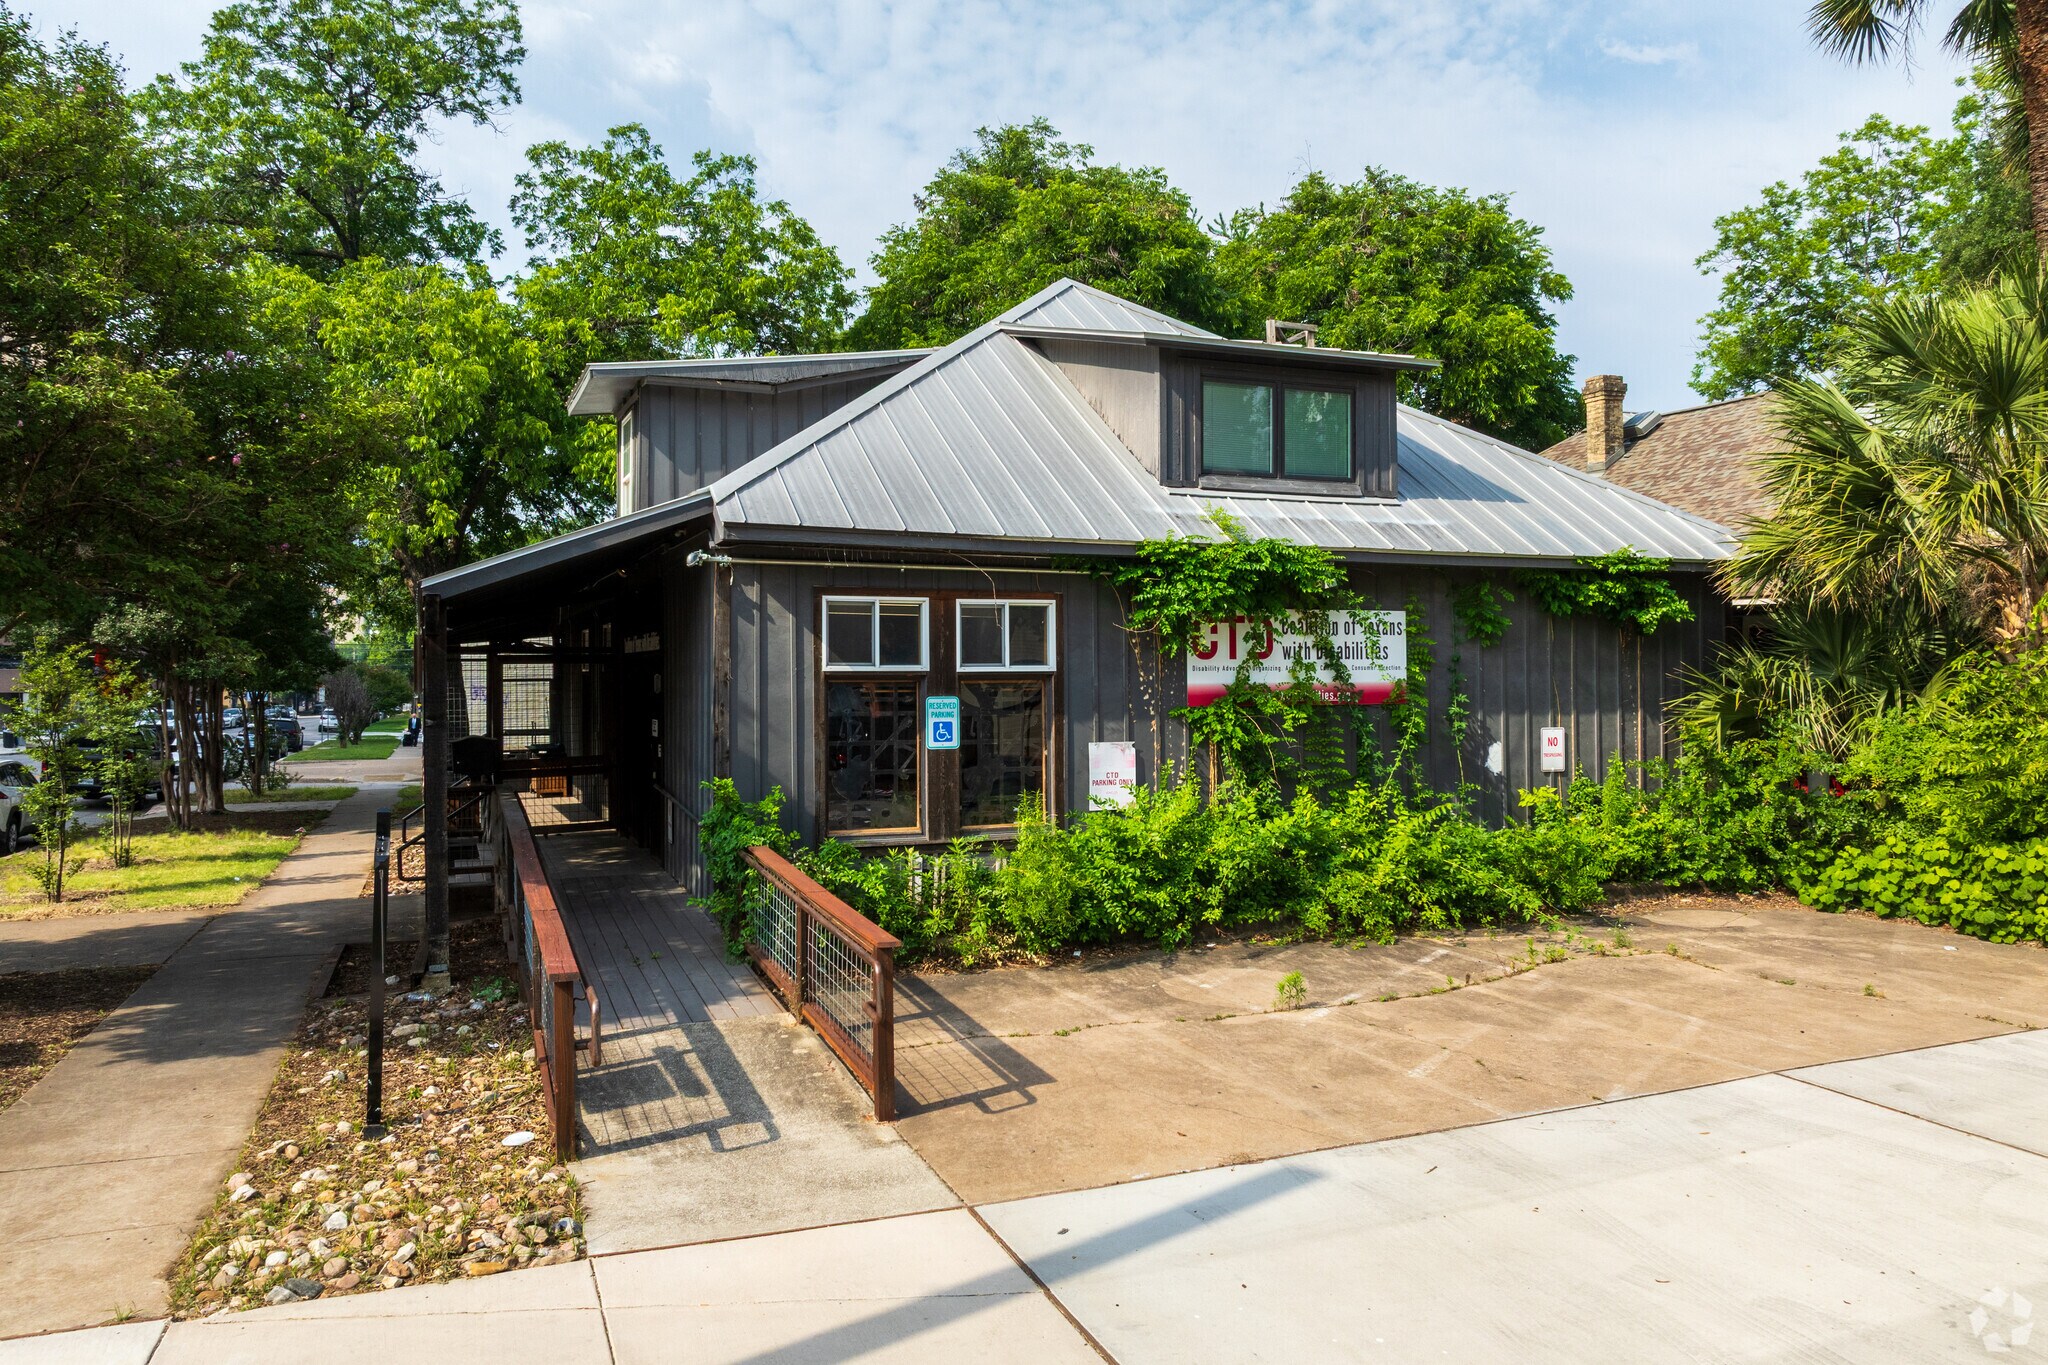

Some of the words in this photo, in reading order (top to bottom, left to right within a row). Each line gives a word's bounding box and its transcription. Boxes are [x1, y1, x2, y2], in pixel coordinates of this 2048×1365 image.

[1282, 617, 1339, 636] Coalton
[1343, 618, 1356, 636] of
[1190, 615, 1274, 660] CTD
[1282, 641, 1311, 660] with
[1316, 641, 1389, 660] Dabilites
[1192, 664, 1220, 673] Disability
[929, 702, 957, 710] RESERVED
[931, 711, 955, 719] PARKING
[1547, 736, 1559, 747] NO
[1092, 779, 1117, 787] PARKING
[1118, 778, 1134, 786] ONLY
